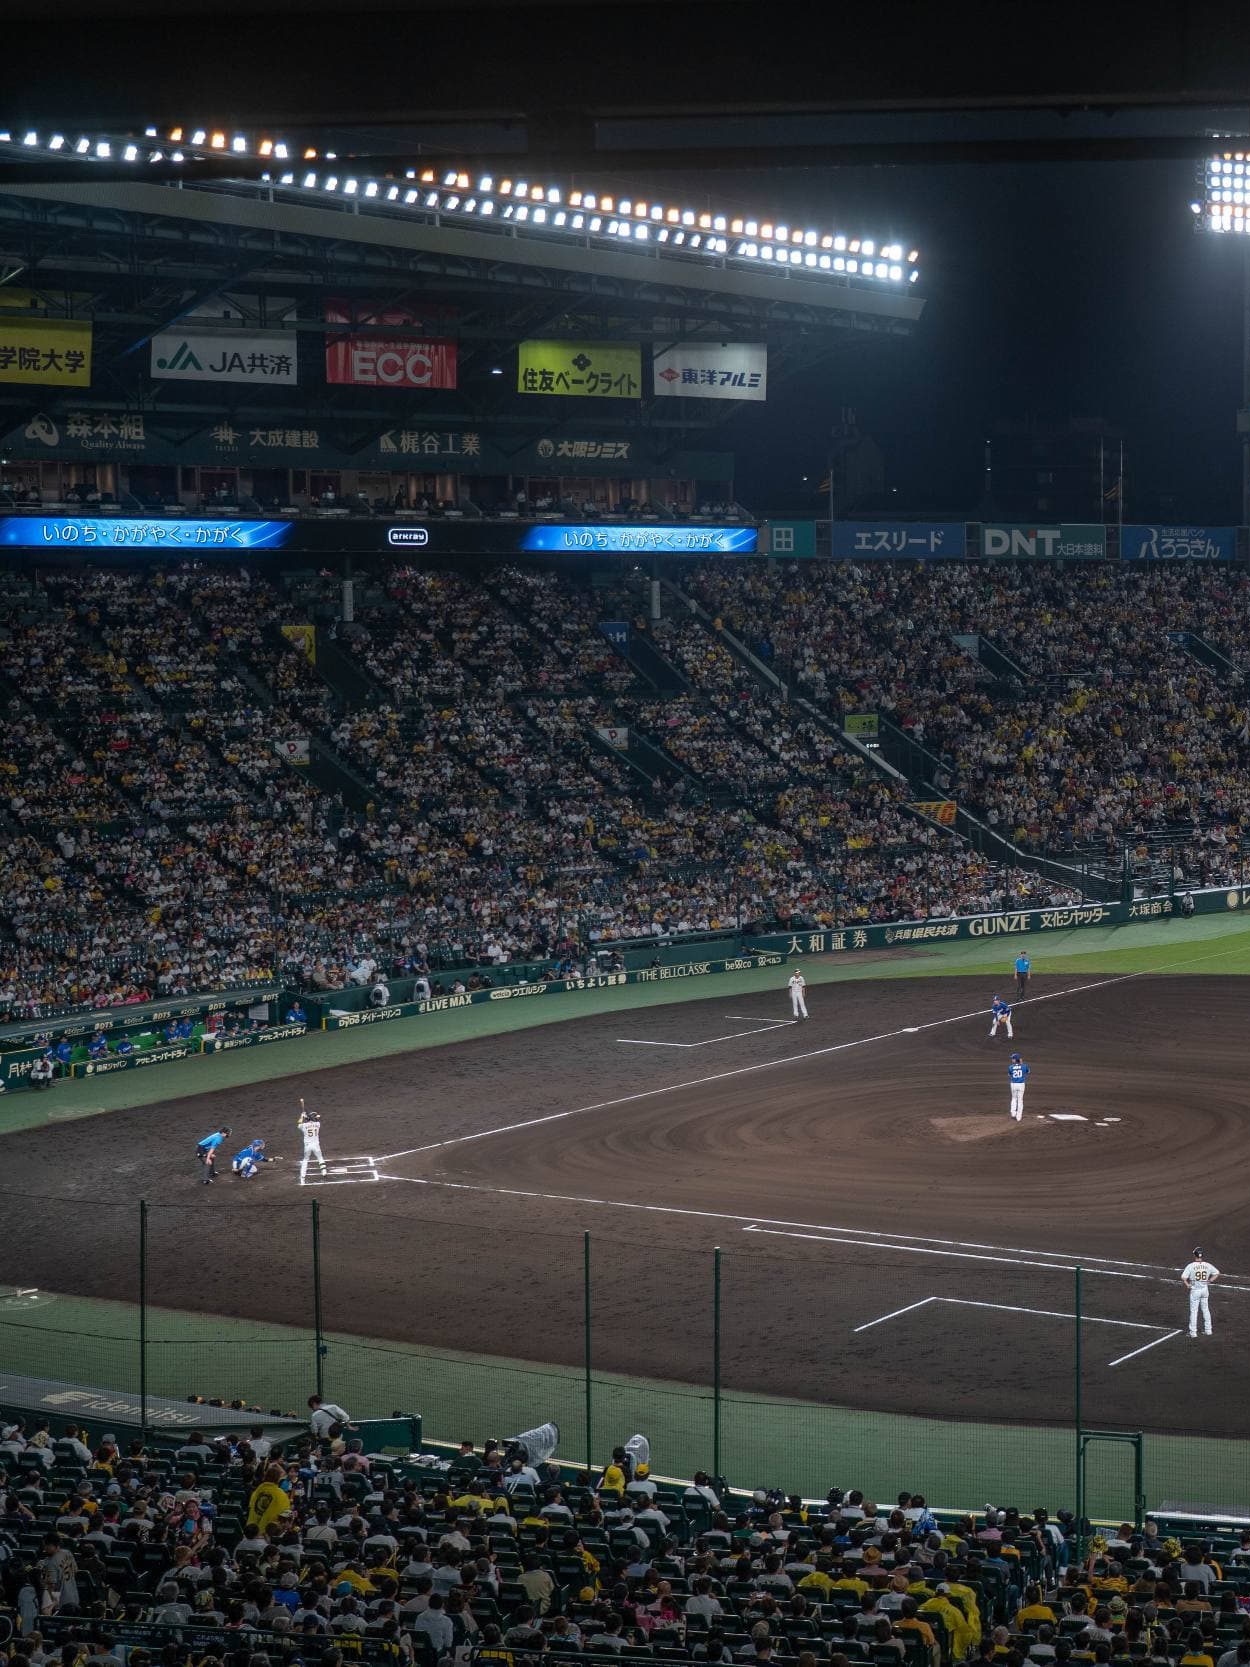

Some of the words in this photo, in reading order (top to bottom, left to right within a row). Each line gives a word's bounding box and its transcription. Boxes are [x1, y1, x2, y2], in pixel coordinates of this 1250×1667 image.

[209, 351, 293, 376] JA共済
[352, 350, 433, 385] ECC
[522, 367, 638, 396] 住友ベークライト
[681, 368, 762, 388] 東洋アルミ
[66, 412, 146, 440] 森本組
[249, 427, 320, 449] 大成建設
[400, 431, 481, 456] 梶谷工業
[556, 441, 631, 460] 大阪シミズ
[854, 530, 945, 552] エスリード
[985, 528, 1061, 556] DNT
[1161, 538, 1220, 558] ろうきん
[1128, 900, 1173, 917] 大塚商会
[968, 914, 1031, 936] GUNZE
[787, 930, 868, 955] 大和証券
[566, 974, 627, 990] いちよし証券
[640, 970, 658, 982] THE
[1012, 1069, 1023, 1078] 20
[307, 1128, 318, 1137] 51
[1194, 1270, 1207, 1281] 96
